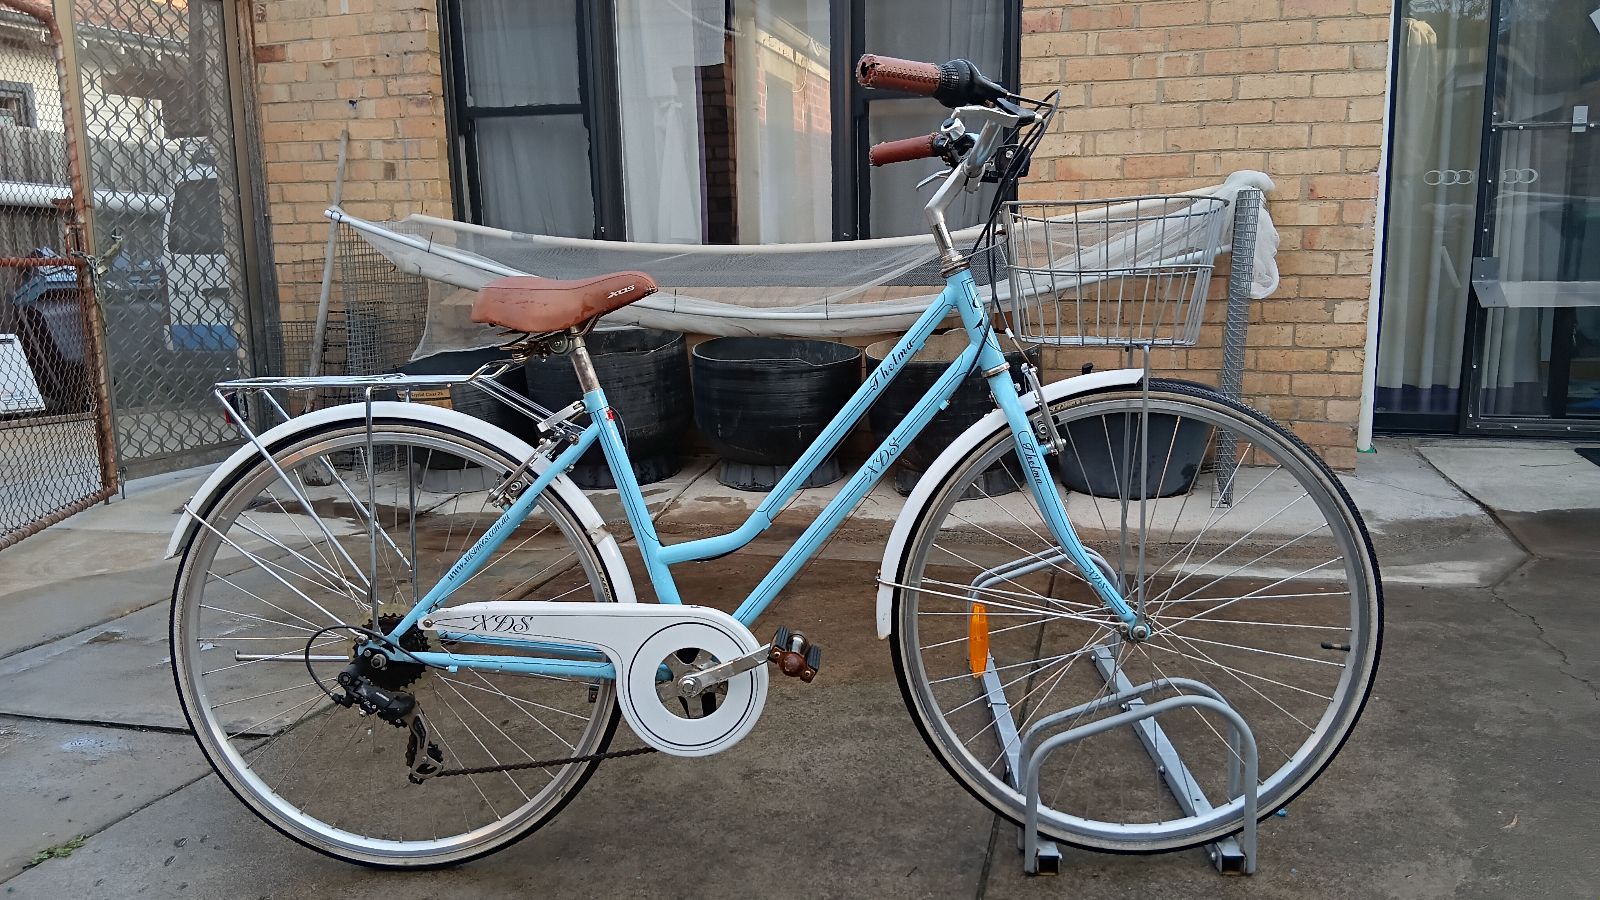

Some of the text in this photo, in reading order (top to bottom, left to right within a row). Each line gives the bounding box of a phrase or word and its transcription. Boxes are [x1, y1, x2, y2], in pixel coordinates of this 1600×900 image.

[869, 339, 915, 391] Thelma
[864, 437, 900, 482] XDS
[1022, 442, 1042, 486] Thelma
[447, 513, 511, 581] www.xdsbikes.com.au
[469, 614, 534, 633] XDS
